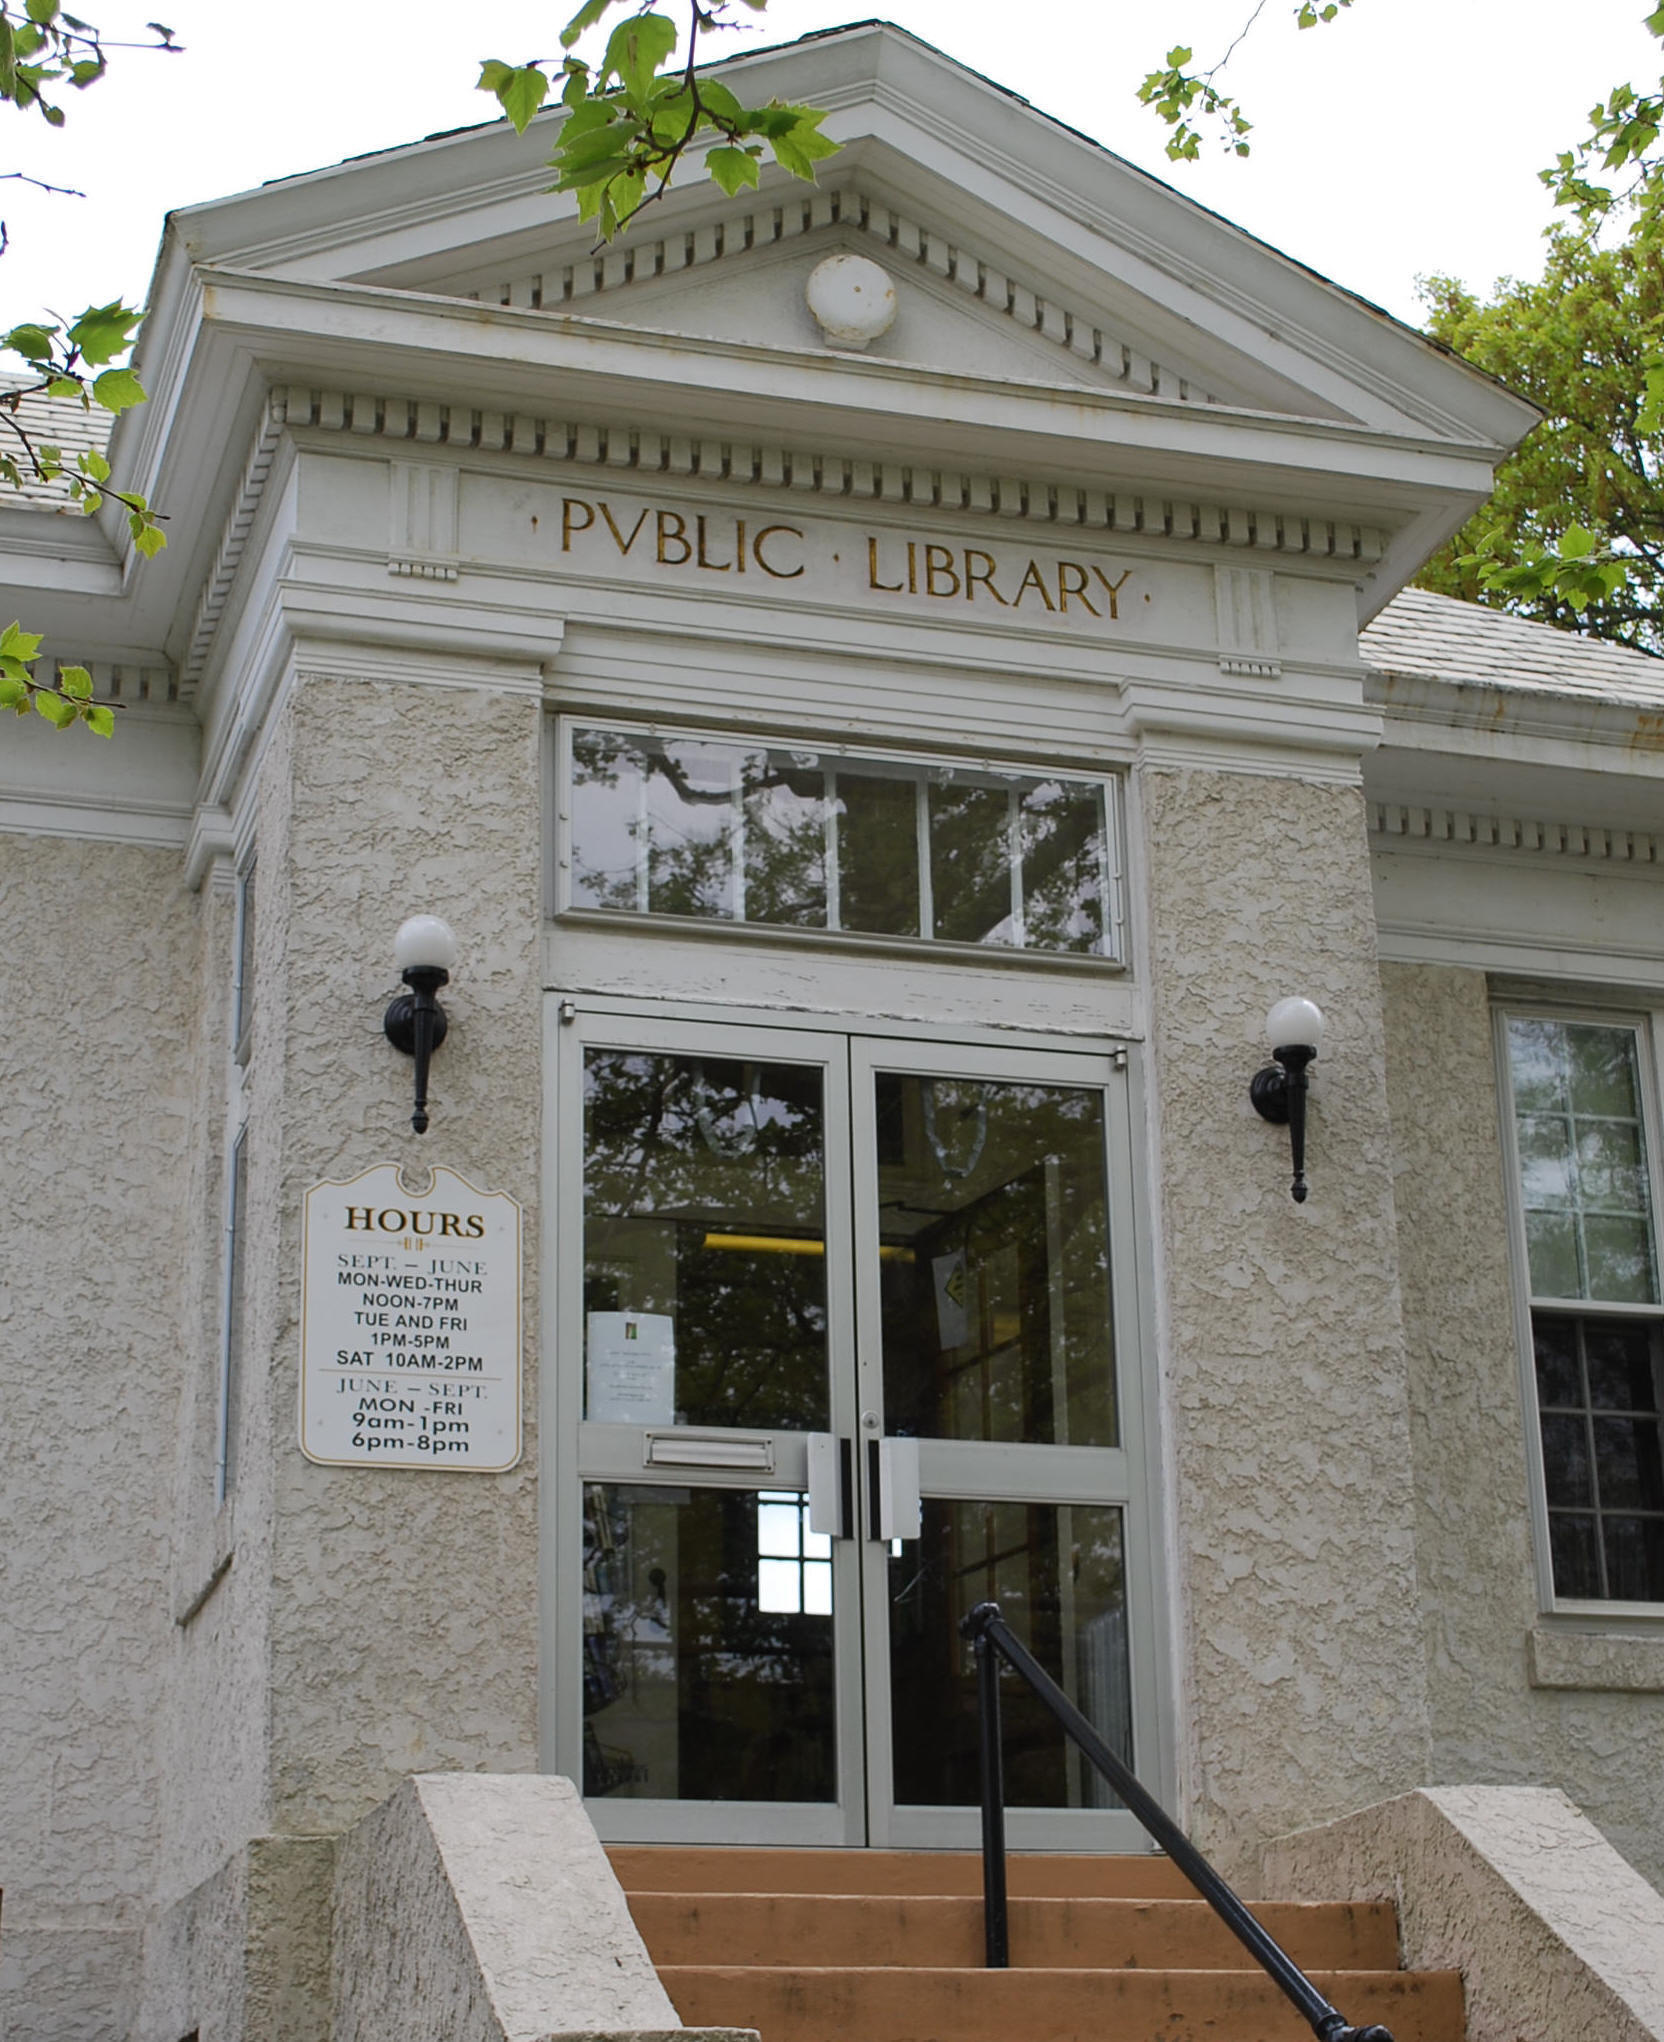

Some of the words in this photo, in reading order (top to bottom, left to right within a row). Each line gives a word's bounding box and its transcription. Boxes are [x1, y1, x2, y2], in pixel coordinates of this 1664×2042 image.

[560, 498, 804, 579] PVBLIC
[867, 536, 1132, 620] LIBRARY
[344, 1206, 485, 1239] HOURS
[337, 1254, 397, 1271] SEPT.
[427, 1259, 488, 1275] JUNE
[338, 1272, 482, 1293] MON-WED-THUR
[363, 1293, 458, 1311] NOON-7PM
[354, 1311, 389, 1326] TUE
[395, 1314, 433, 1329] AND
[440, 1317, 467, 1331] FRI
[371, 1332, 449, 1349] 1PM-5PM
[337, 1350, 374, 1366] SAT
[386, 1352, 483, 1371] 10AM-2PM
[336, 1378, 398, 1394] JUNE
[428, 1382, 488, 1399] SEPT.
[359, 1397, 415, 1412] MON
[352, 1412, 469, 1435] 9am-1pm
[352, 1432, 469, 1454] 6pm-8pm
